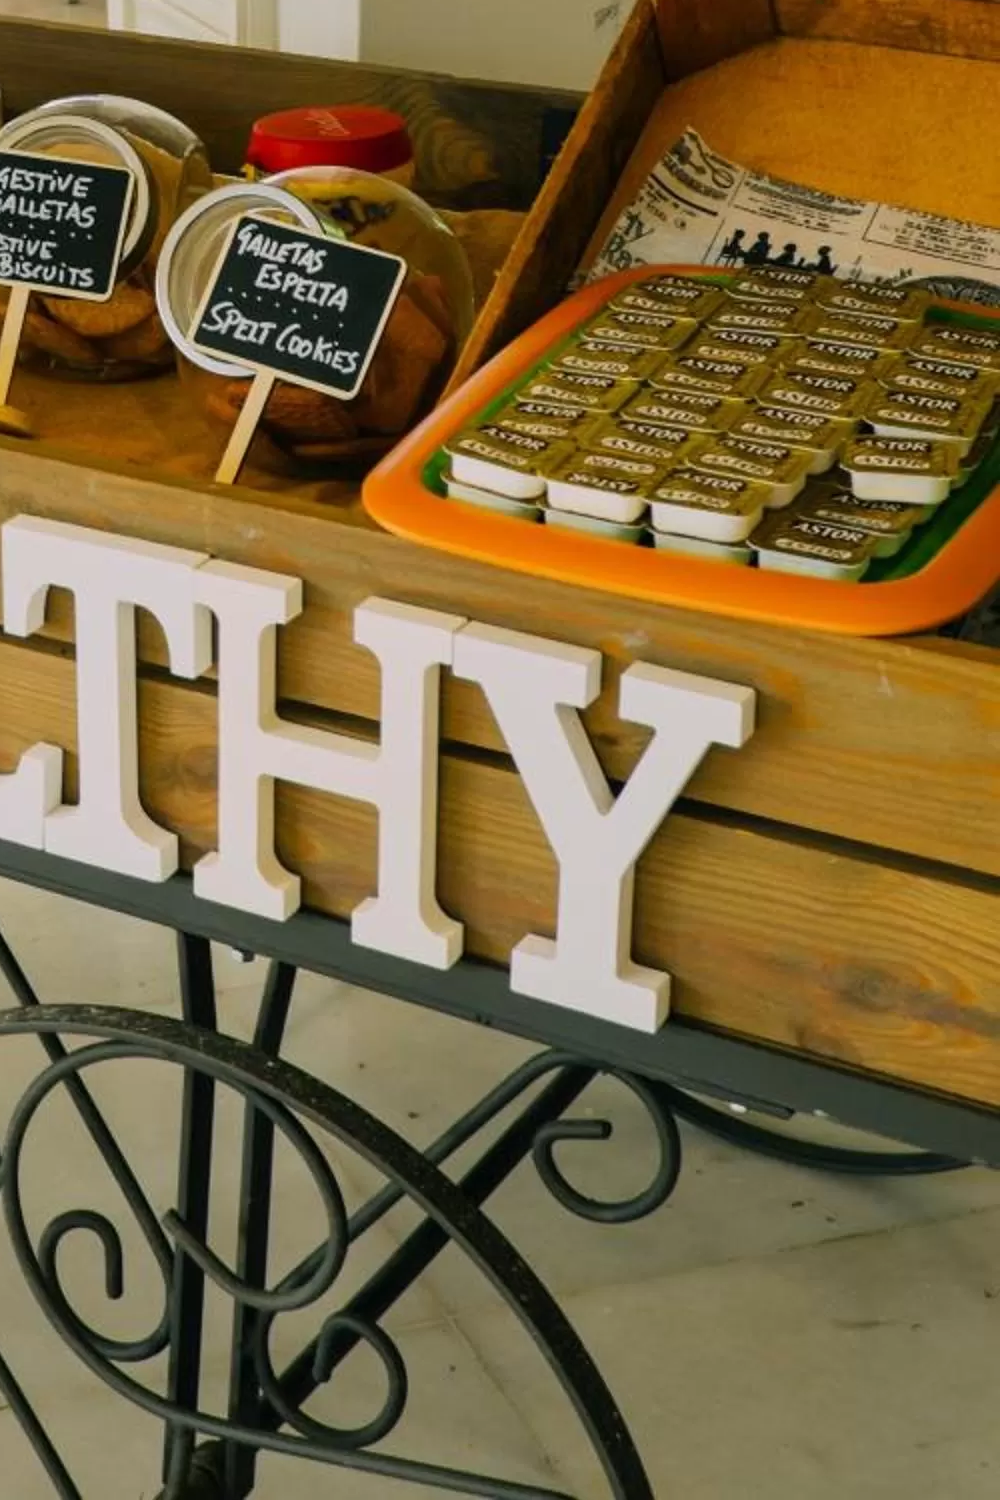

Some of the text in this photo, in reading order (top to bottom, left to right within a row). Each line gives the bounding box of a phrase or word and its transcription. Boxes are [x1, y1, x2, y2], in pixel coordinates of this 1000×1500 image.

[236, 224, 327, 274] GALLETAS
[843, 282, 905, 300] ASTOR
[201, 300, 277, 347] SPELT
[616, 314, 674, 329] ASTOR
[714, 331, 777, 348] ASTOR
[937, 331, 1000, 349] ASTOR
[810, 341, 876, 361] ASTOR
[679, 358, 743, 375] ASTOR
[908, 361, 976, 380] ASTOR
[790, 374, 853, 393] ASTOR
[653, 391, 719, 407] ASTOR
[890, 392, 958, 411] ASTOR
[518, 404, 581, 419] ASTOR
[759, 408, 825, 428] ASTOR
[482, 426, 547, 451] ASTOR
[620, 422, 687, 442] ASTOR
[720, 439, 787, 459] ASTOR
[860, 438, 929, 453] ASTOR
[676, 473, 744, 493] ASTOR
[795, 522, 866, 543] ASTOR
